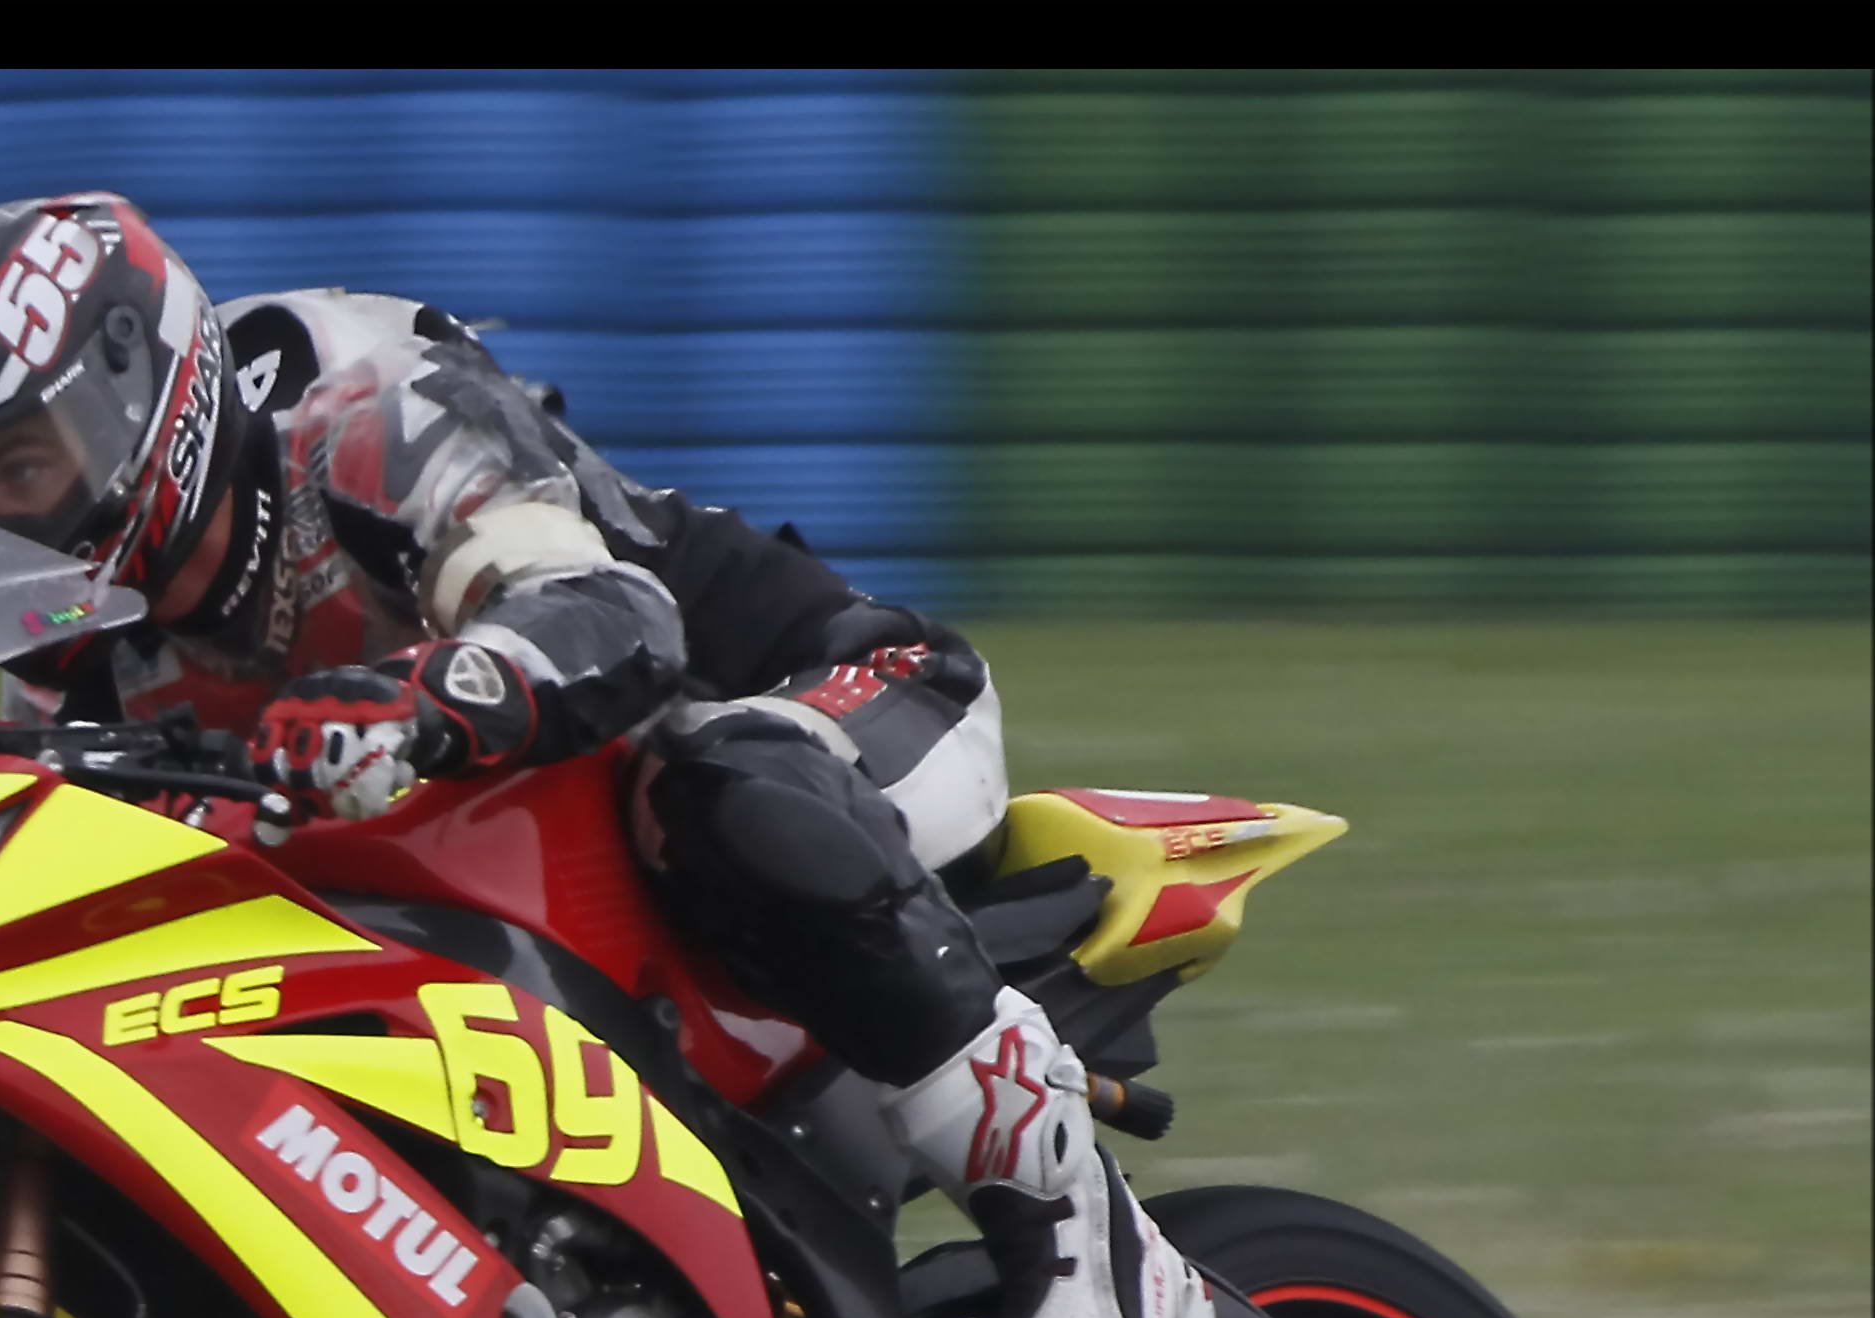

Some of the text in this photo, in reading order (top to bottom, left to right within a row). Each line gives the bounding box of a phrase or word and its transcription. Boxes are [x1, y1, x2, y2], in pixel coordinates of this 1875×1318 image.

[102, 964, 285, 1047] ECS
[417, 982, 643, 1186] 69
[256, 1104, 481, 1308] MOTUL
